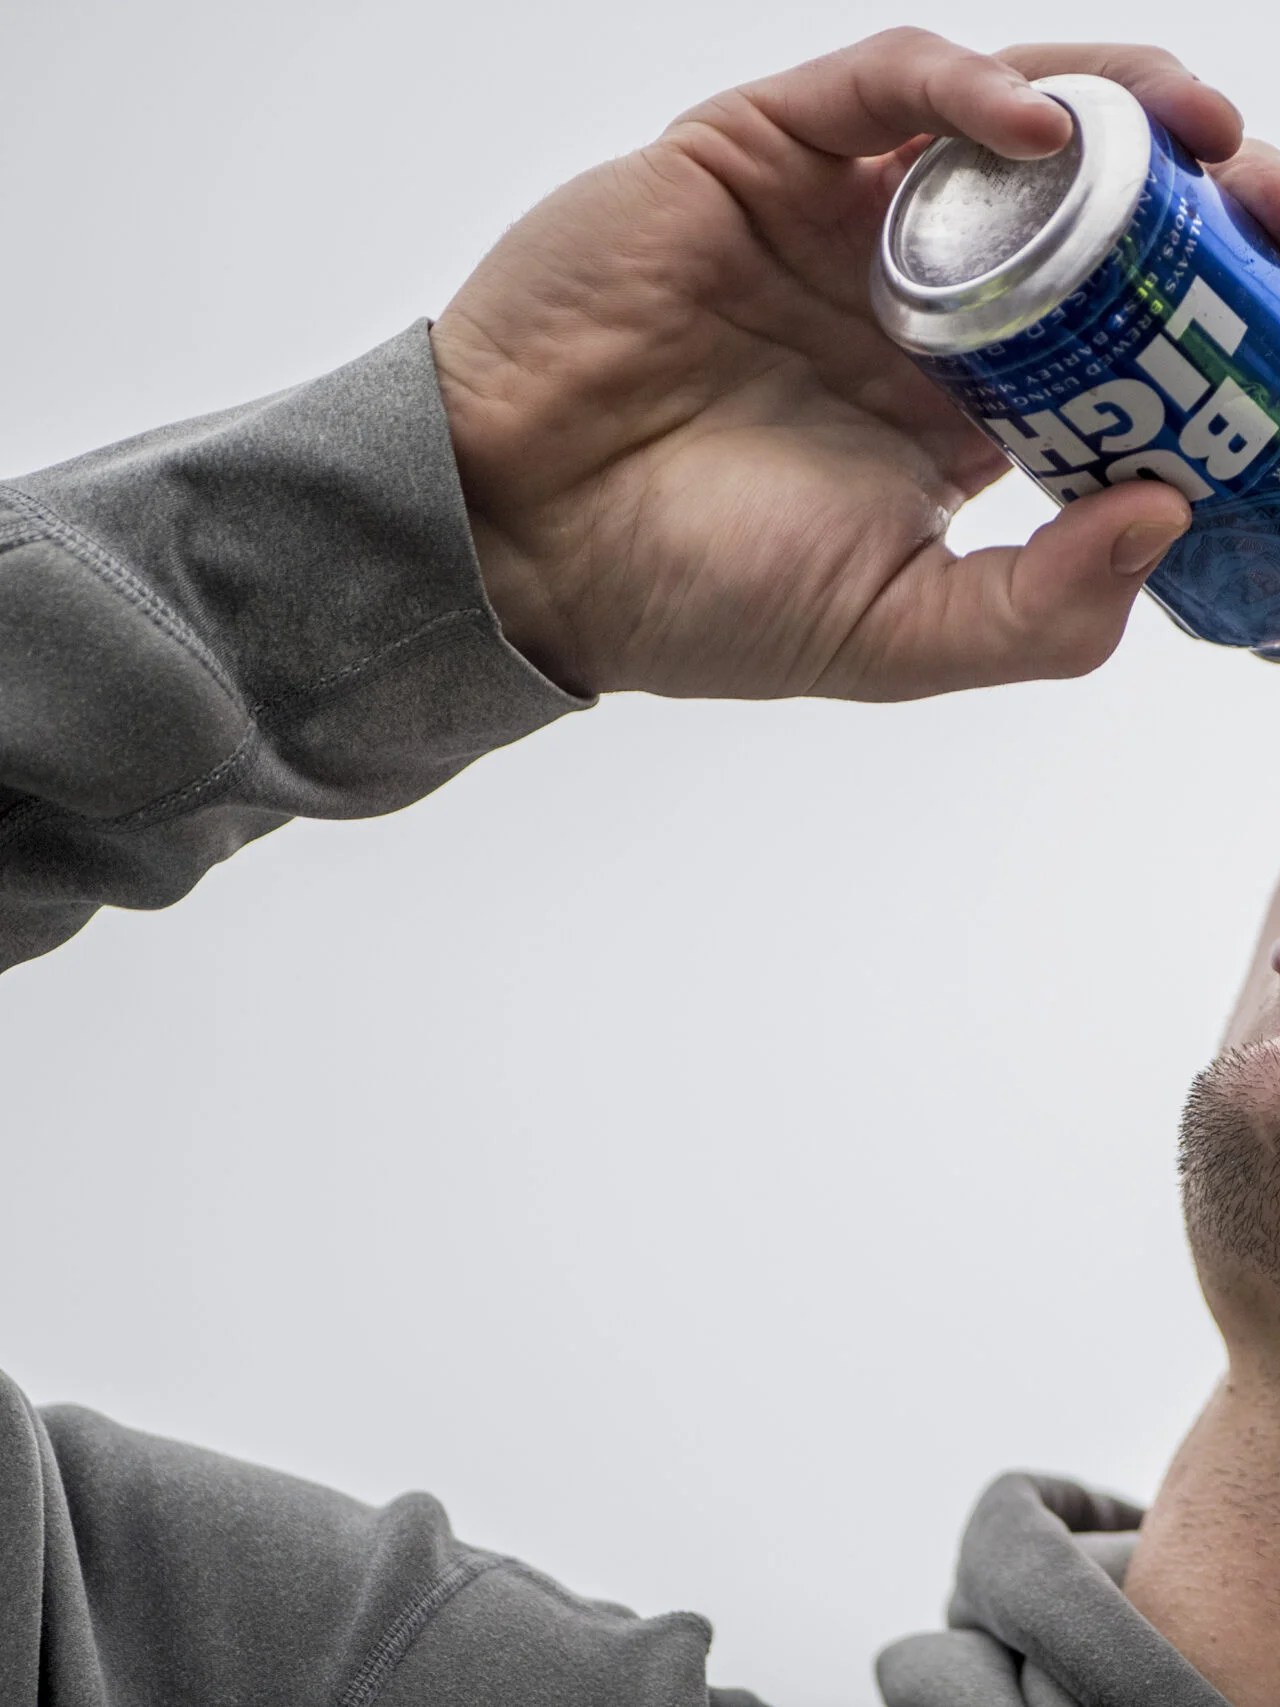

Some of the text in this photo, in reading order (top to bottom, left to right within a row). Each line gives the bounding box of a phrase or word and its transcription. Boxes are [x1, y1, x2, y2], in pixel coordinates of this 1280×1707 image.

[1164, 213, 1201, 294] ALWAYS
[1024, 329, 1108, 387] BARLEY
[1086, 298, 1165, 375] BREWED
[1011, 375, 1079, 408] USING
